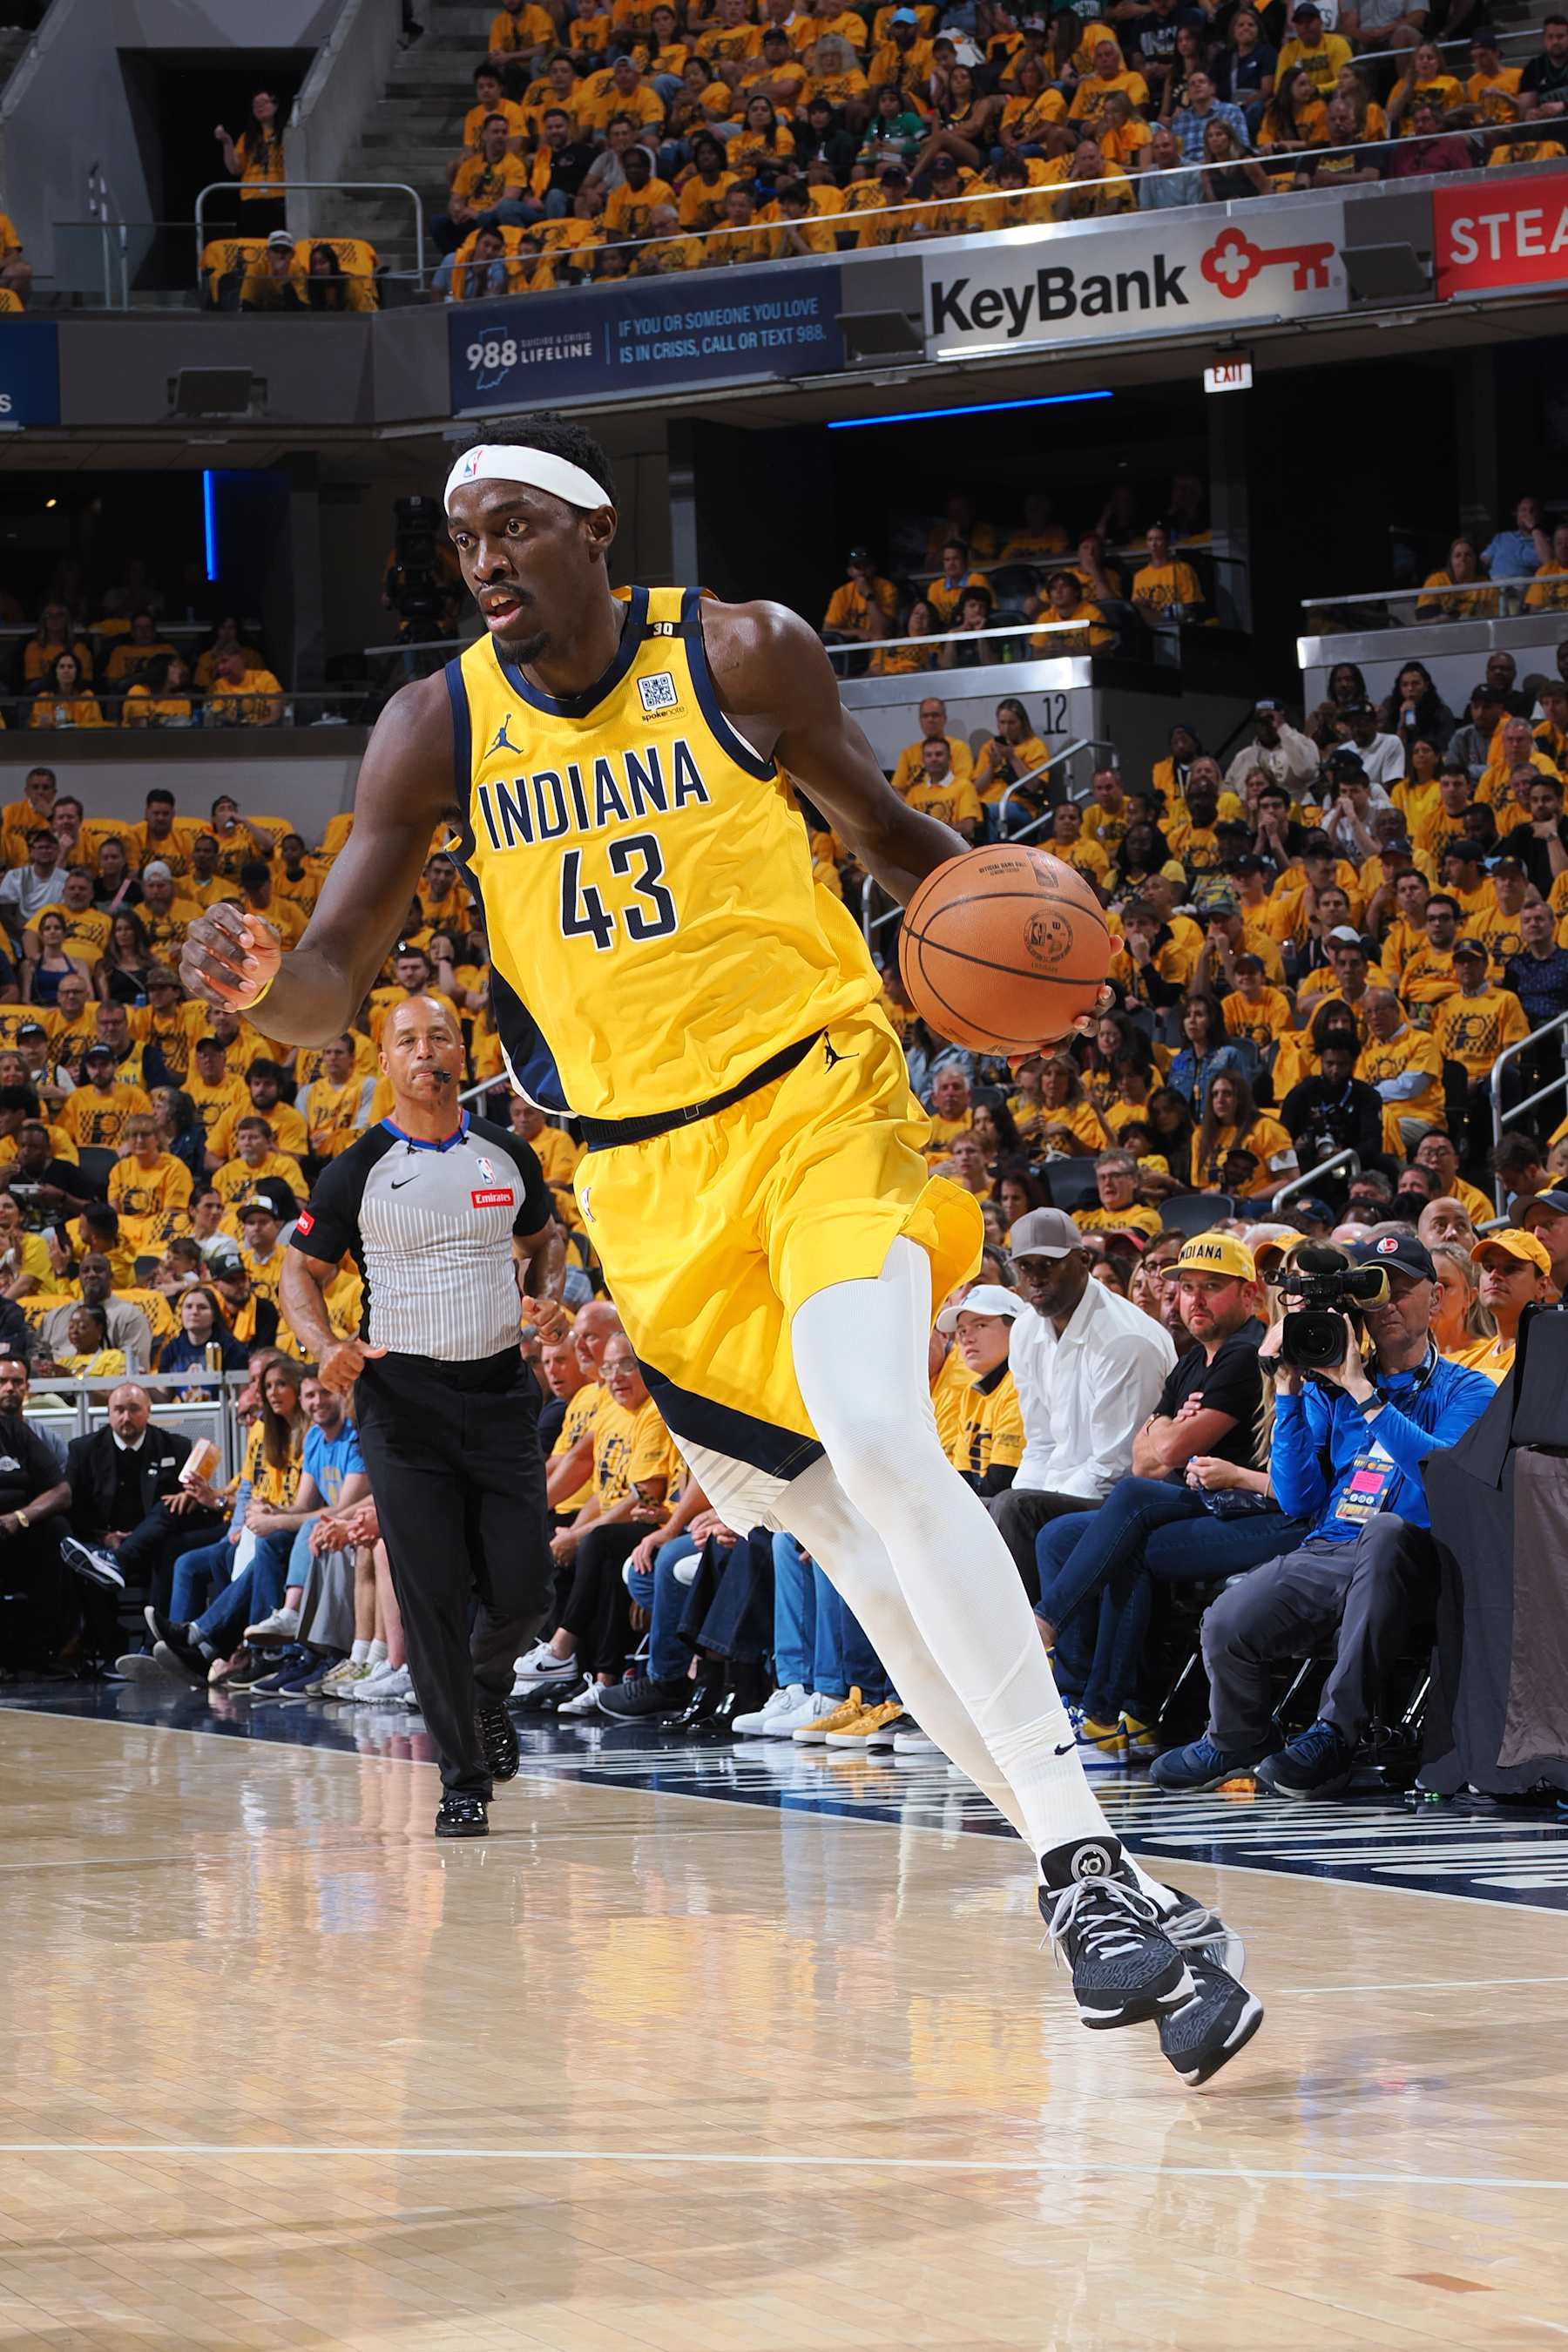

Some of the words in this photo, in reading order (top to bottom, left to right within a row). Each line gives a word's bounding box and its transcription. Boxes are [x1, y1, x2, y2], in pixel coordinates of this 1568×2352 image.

[929, 253, 1190, 338] KeyBank
[618, 320, 632, 338] IF
[633, 316, 660, 335] YOU
[663, 314, 683, 333] OR
[685, 306, 751, 329] SOMEONE
[753, 301, 781, 321] YOU
[784, 297, 819, 317] LOVE
[466, 339, 517, 370] 988
[521, 342, 592, 363] LIFELINE
[619, 347, 633, 363] IS
[636, 344, 650, 362] IN
[652, 339, 700, 360] CRISIS,
[701, 335, 736, 355] CALL
[737, 332, 758, 349] OR
[760, 327, 794, 347] TEXT
[796, 323, 827, 342] 988.
[653, 622, 673, 636] 30
[641, 706, 685, 722] spokenote
[1043, 693, 1068, 735] 12
[477, 739, 711, 851] INDIANA
[560, 832, 678, 951] 43
[475, 1193, 511, 1204] Emirates
